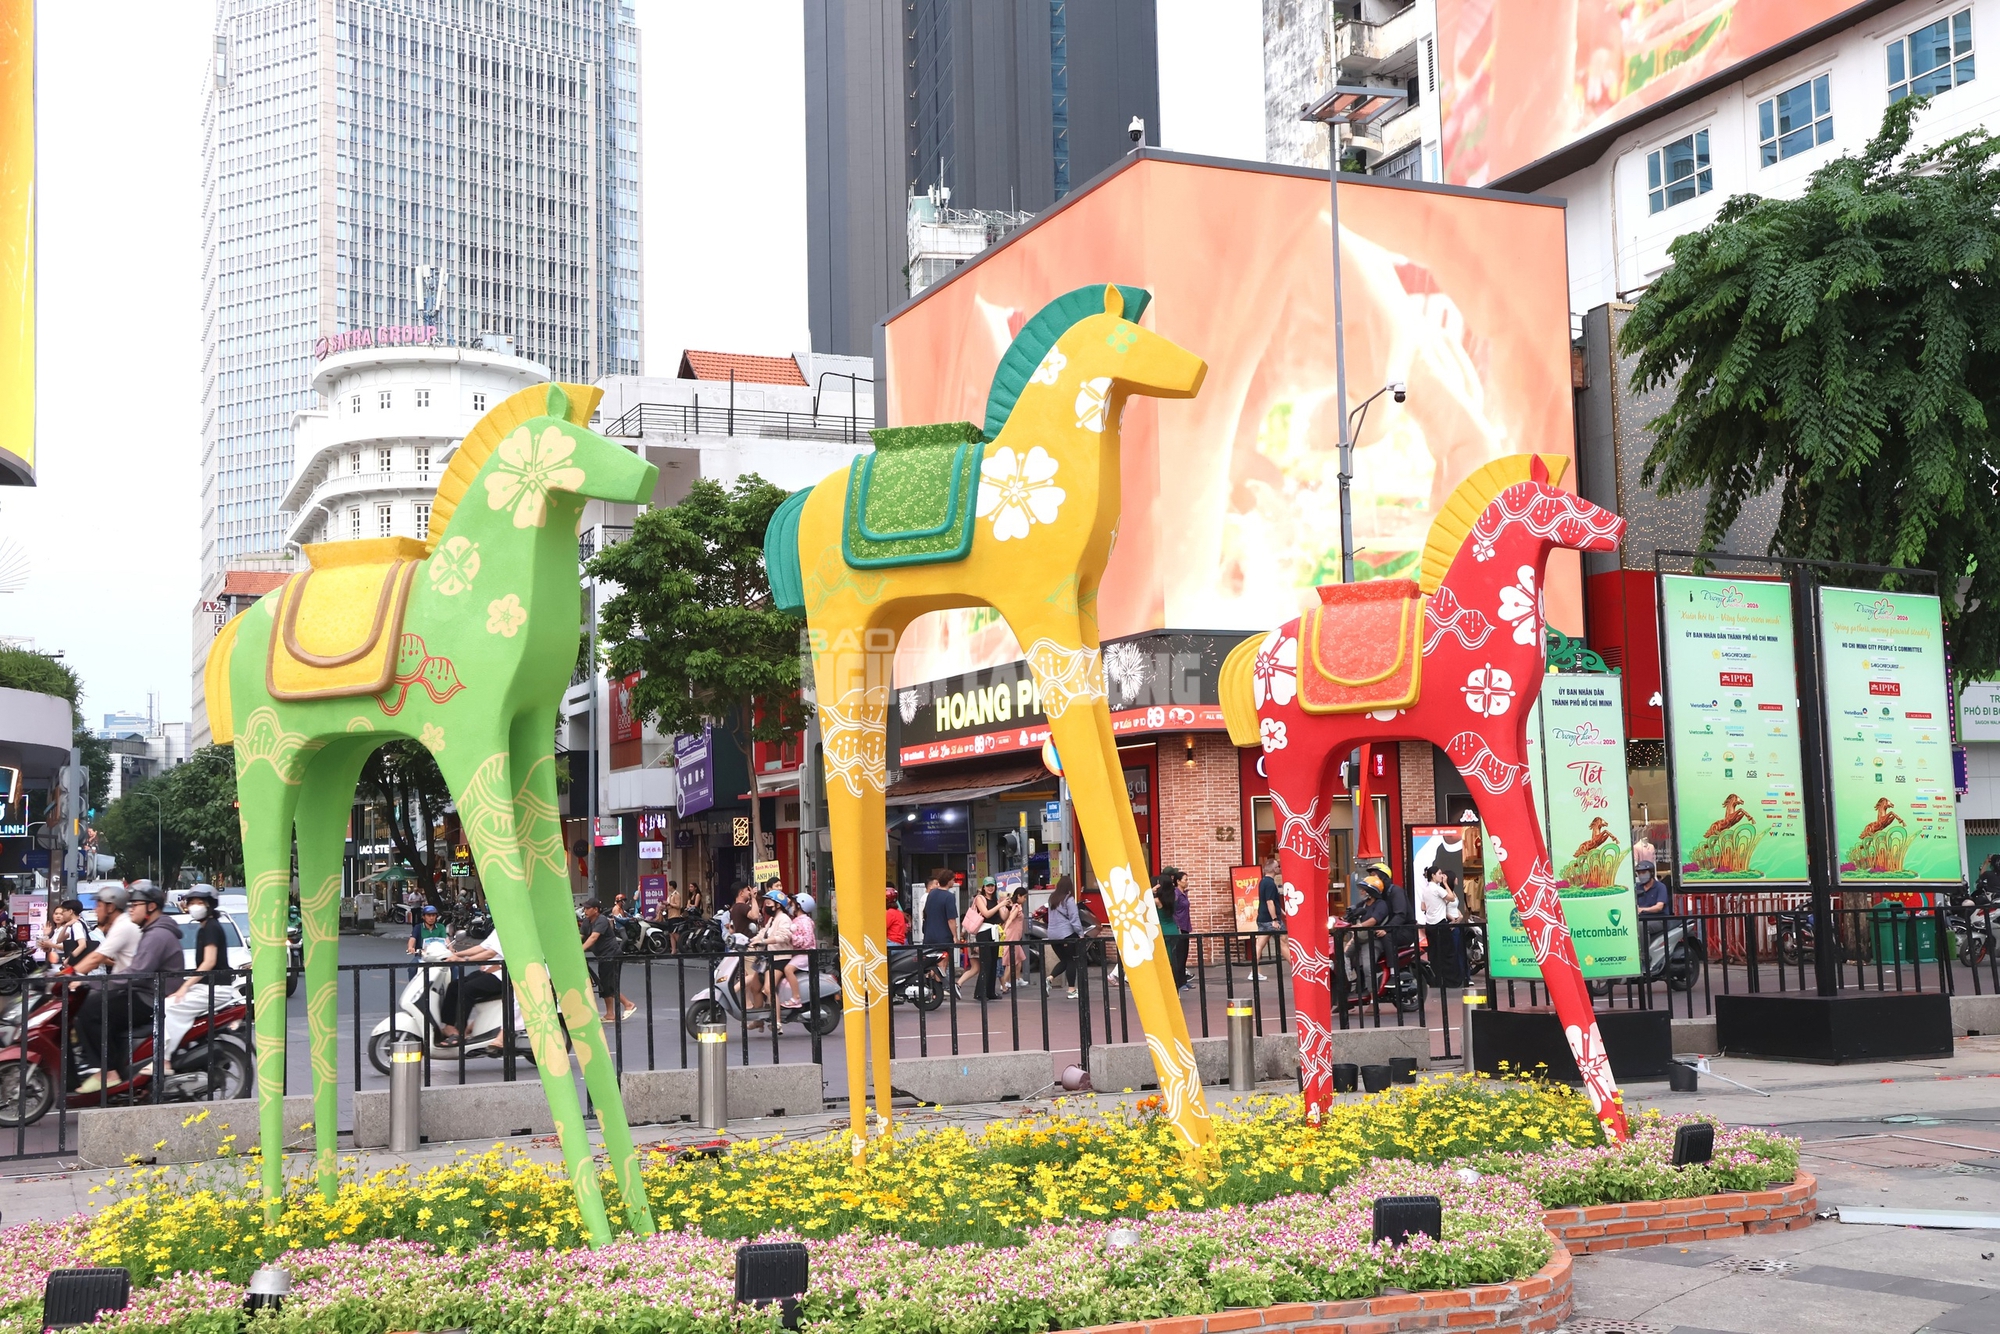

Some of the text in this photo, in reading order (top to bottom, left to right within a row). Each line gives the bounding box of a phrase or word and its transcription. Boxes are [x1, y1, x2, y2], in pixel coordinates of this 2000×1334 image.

[331, 328, 373, 352] SATRA
[377, 325, 438, 344] GROUP
[203, 601, 227, 613] A25
[1692, 631, 1703, 639] BAN
[1703, 631, 1717, 639] NHÂN
[1717, 632, 1727, 640] DÂN
[1742, 633, 1751, 641] PHỐ
[1752, 633, 1758, 641] HỒ
[1898, 645, 1923, 653] COMMITTEE
[1730, 674, 1752, 683] IPPG
[1566, 688, 1578, 696] BAN
[1578, 687, 1593, 696] NHÂN
[1593, 687, 1605, 696] DÂN
[1879, 683, 1899, 692] IPPG
[1551, 697, 1613, 707] THÀNH PHỐ HỒ CHÍ MINH
[936, 683, 1011, 732] HOANG
[1982, 706, 1992, 716] ĐI
[1992, 706, 2000, 716] B
[1566, 760, 1607, 786] Tết
[1215, 825, 1236, 842] 52
[977, 833, 986, 847] 37
[1594, 955, 1627, 963] SAIGONTOURIST
